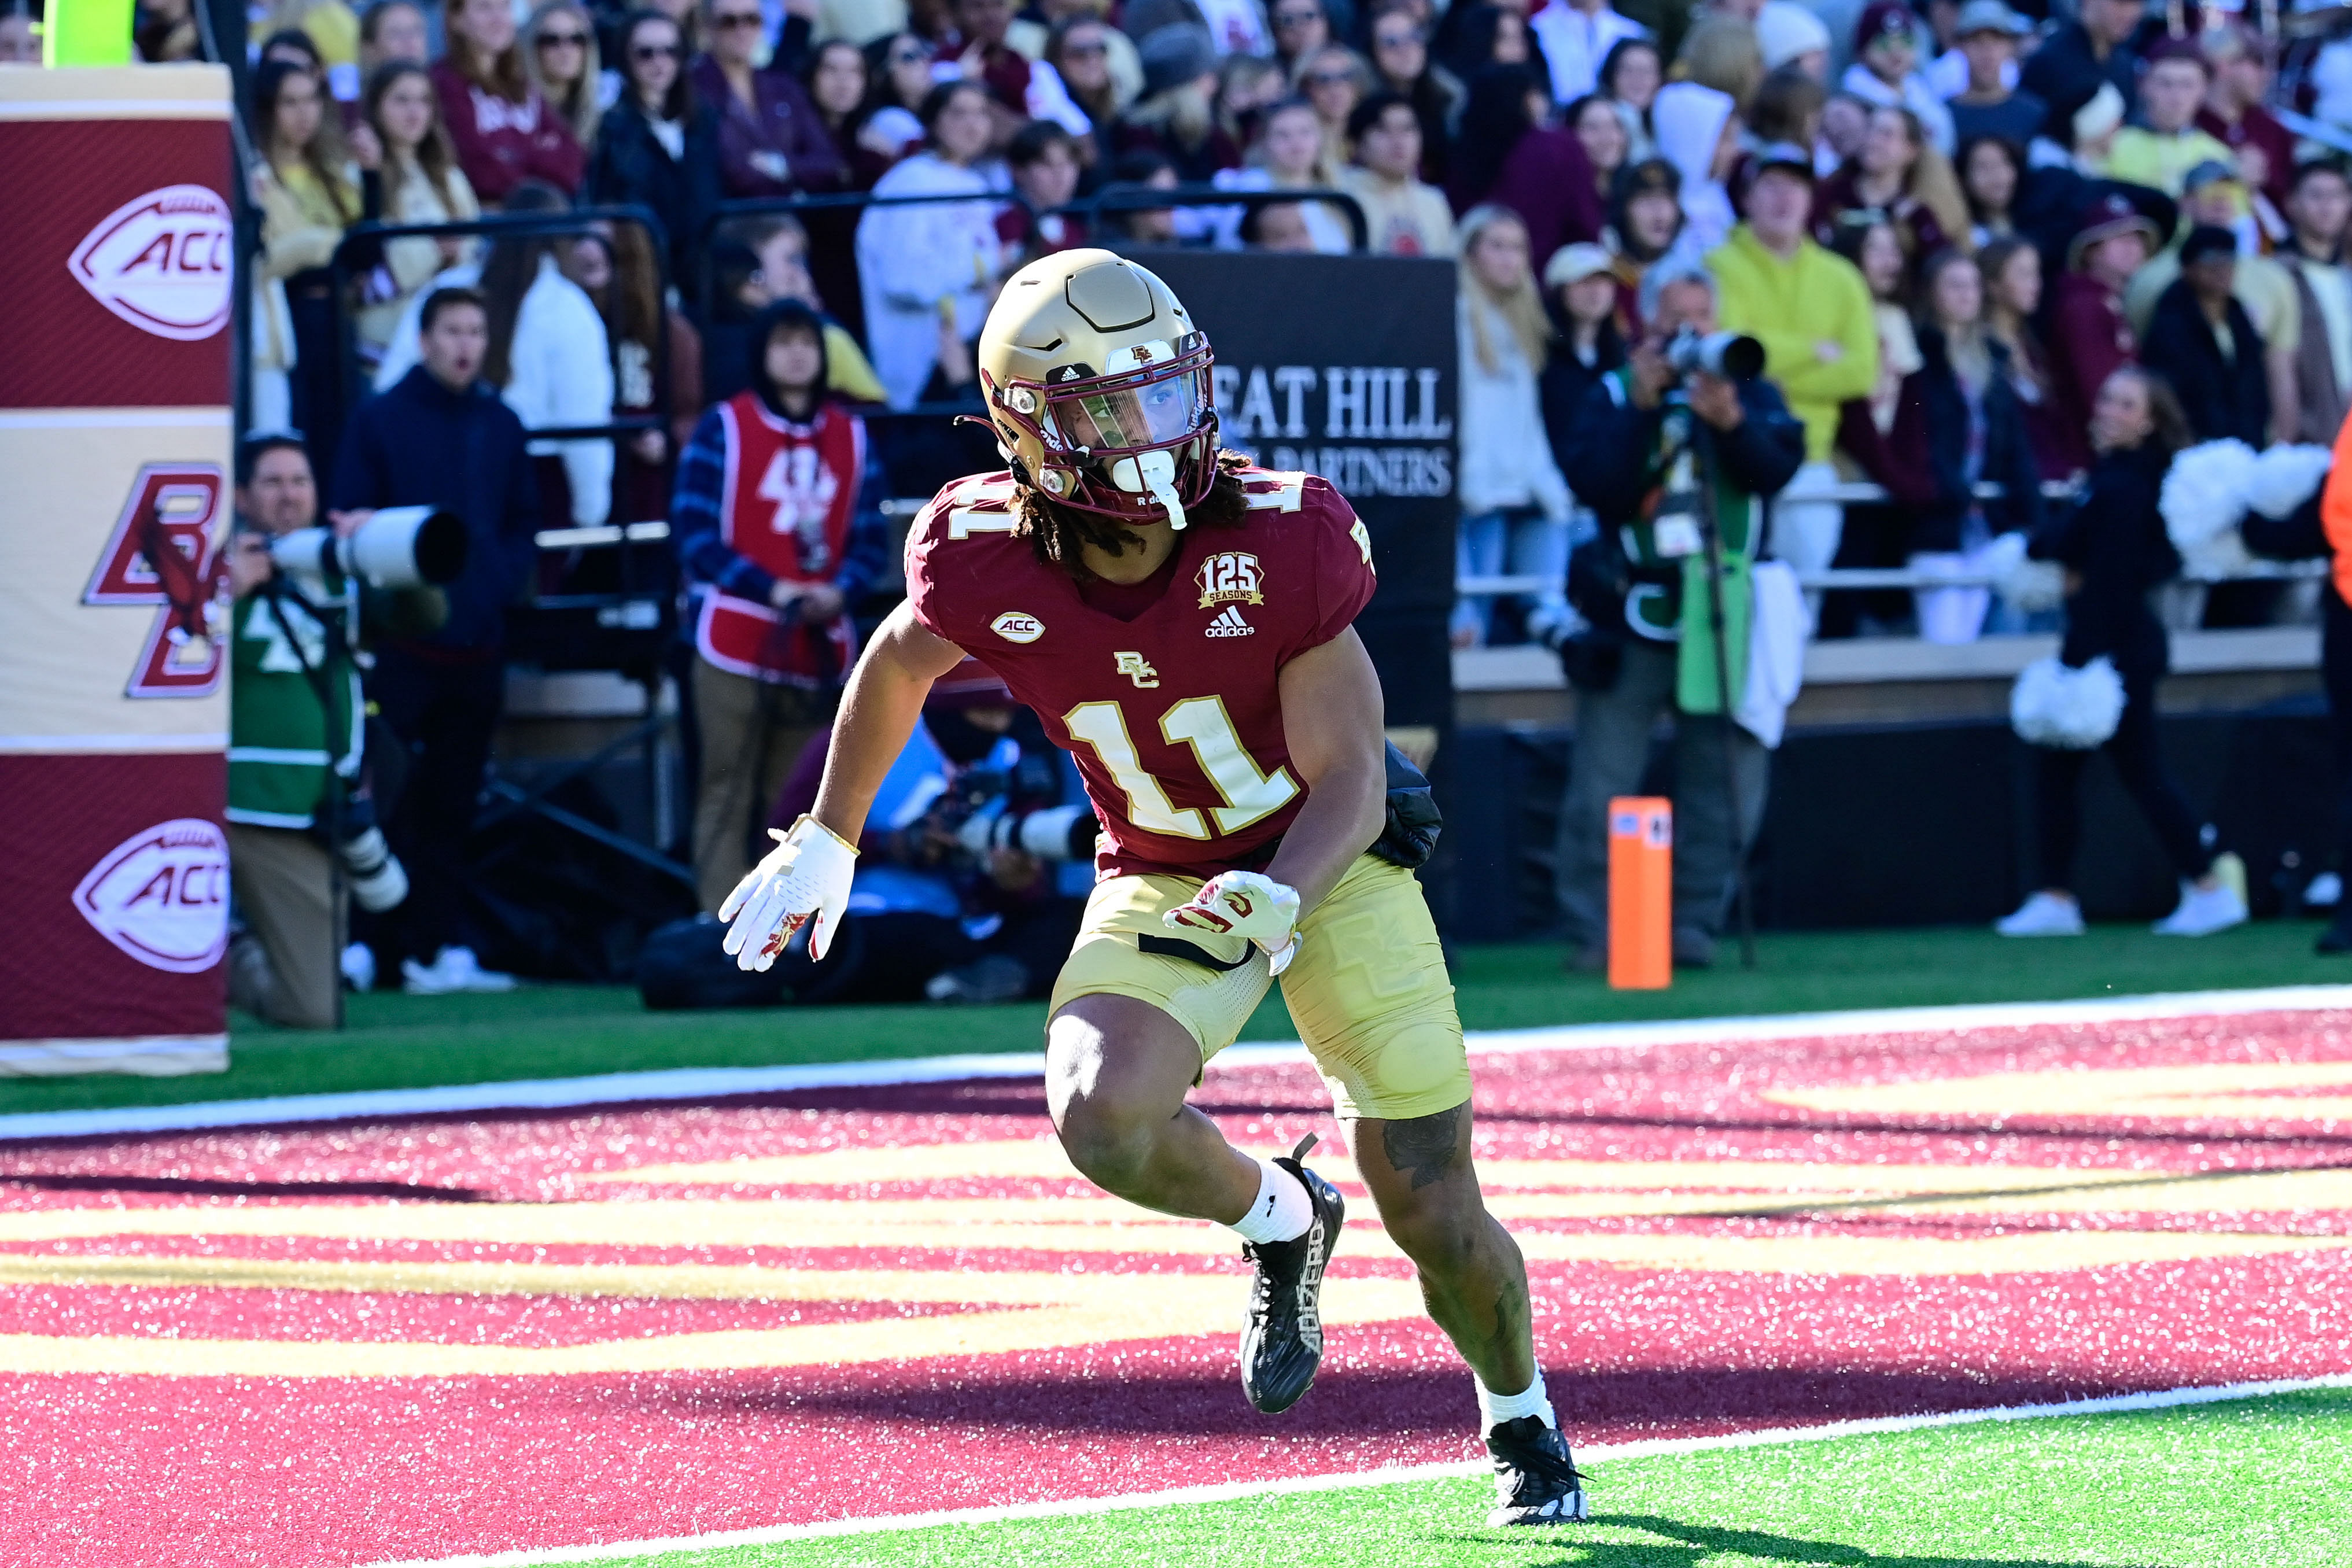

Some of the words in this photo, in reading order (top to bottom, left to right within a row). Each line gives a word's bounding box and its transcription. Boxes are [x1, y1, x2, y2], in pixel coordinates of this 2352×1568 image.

[1324, 367, 1453, 440] HILL
[1203, 555, 1256, 594] 125
[1209, 590, 1253, 602] SEASONS
[999, 619, 1035, 632] ACC
[1205, 625, 1255, 638] adidas
[1113, 651, 1160, 689] BC
[1061, 694, 1300, 840] 11
